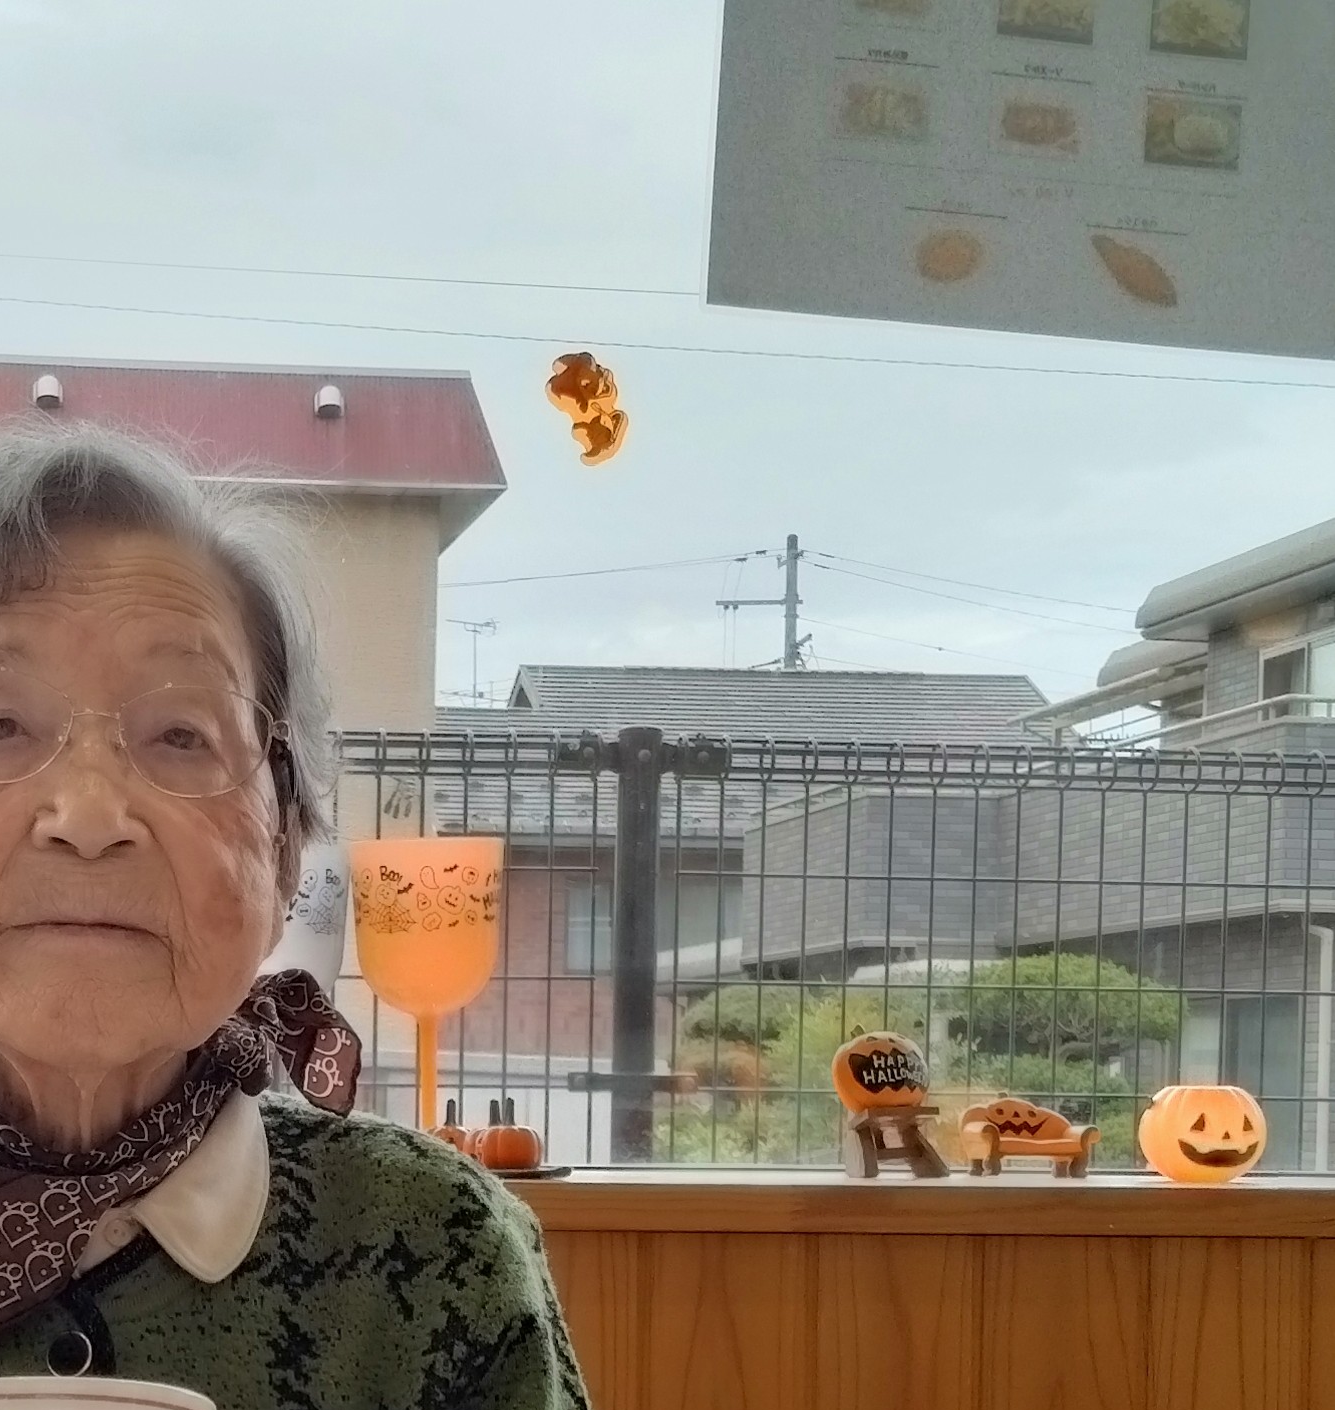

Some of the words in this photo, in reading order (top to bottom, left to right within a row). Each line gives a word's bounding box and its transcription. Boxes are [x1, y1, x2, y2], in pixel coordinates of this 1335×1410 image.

[872, 1054, 922, 1072] HAPPY
[40, 1178, 82, 1227] Dior
[24, 1239, 66, 1293] Dior
